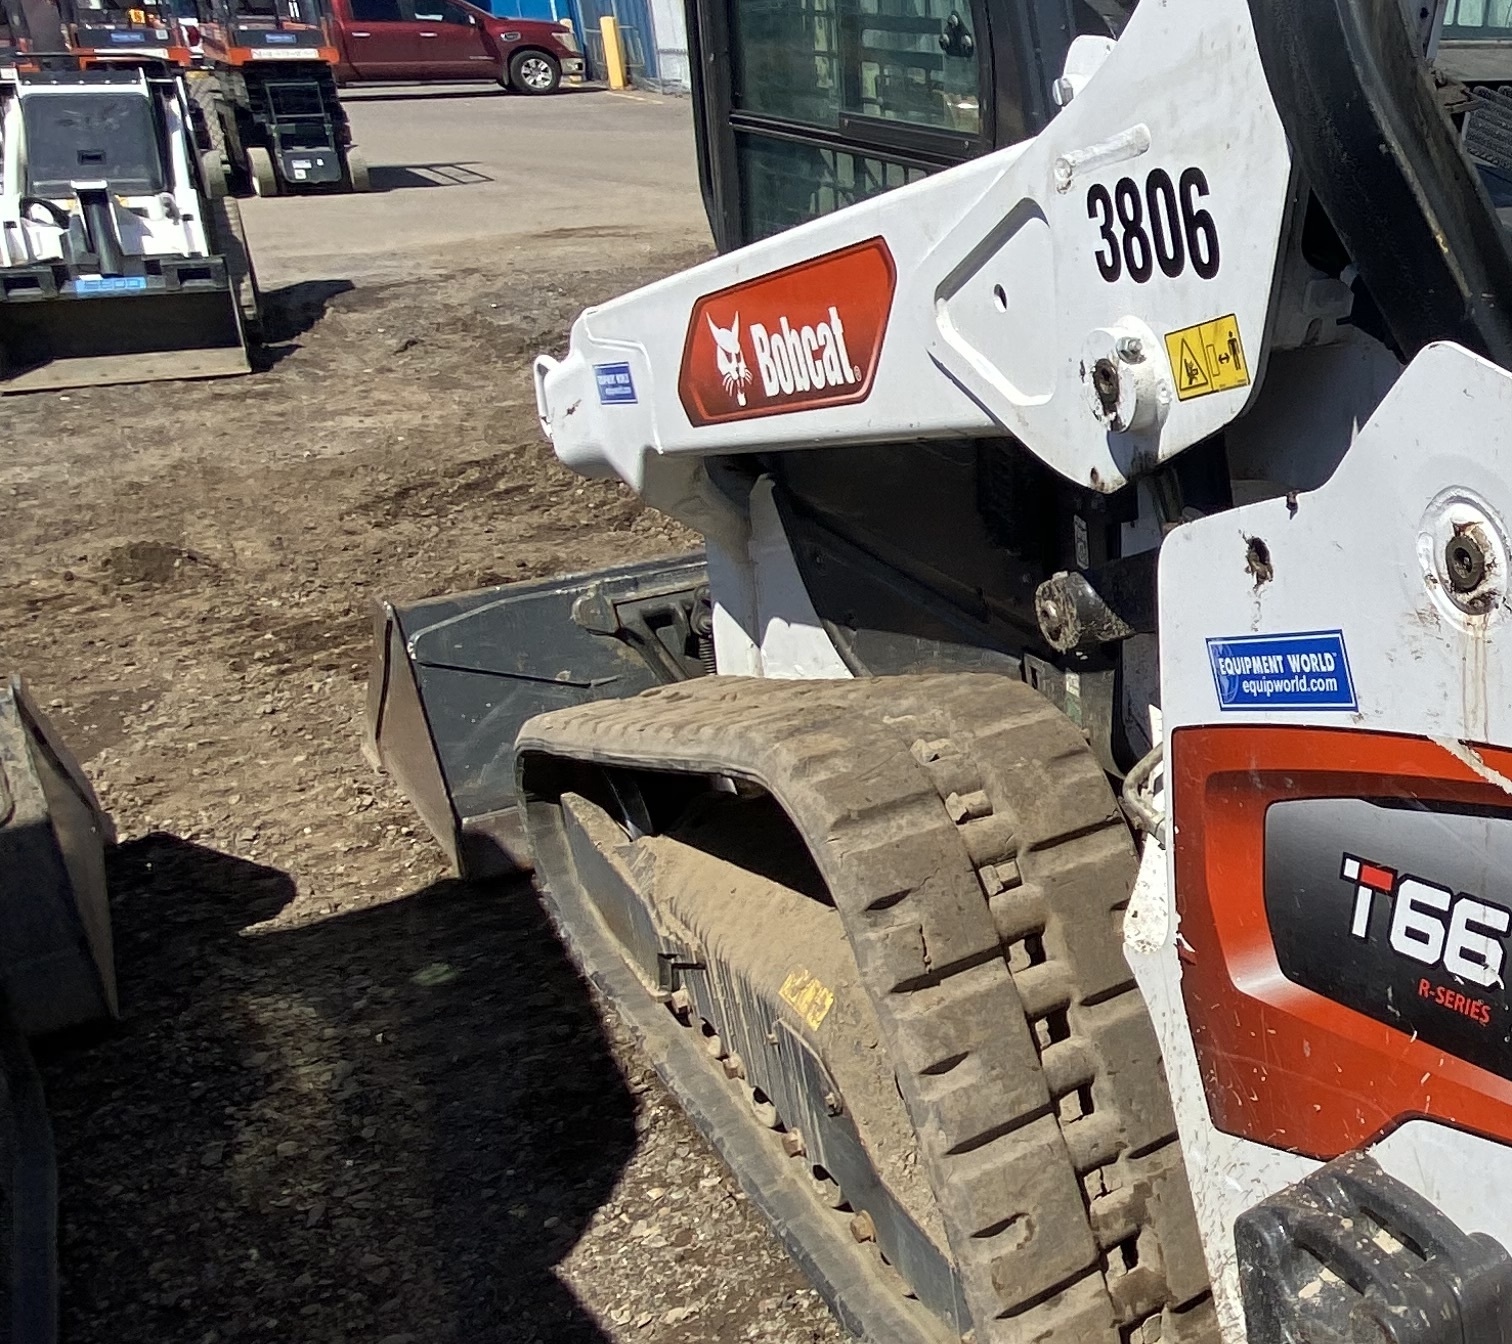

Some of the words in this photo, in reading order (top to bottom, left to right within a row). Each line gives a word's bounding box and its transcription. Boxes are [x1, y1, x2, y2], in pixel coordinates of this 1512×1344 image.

[1087, 167, 1220, 283] 3806
[750, 306, 856, 397] Bobcat
[1218, 655, 1285, 675] EQUIPMENT
[1286, 652, 1336, 673] WORLD
[1242, 675, 1338, 697] equipworld.com
[1341, 854, 1512, 990] T66
[1418, 977, 1492, 1025] R-SERIES
